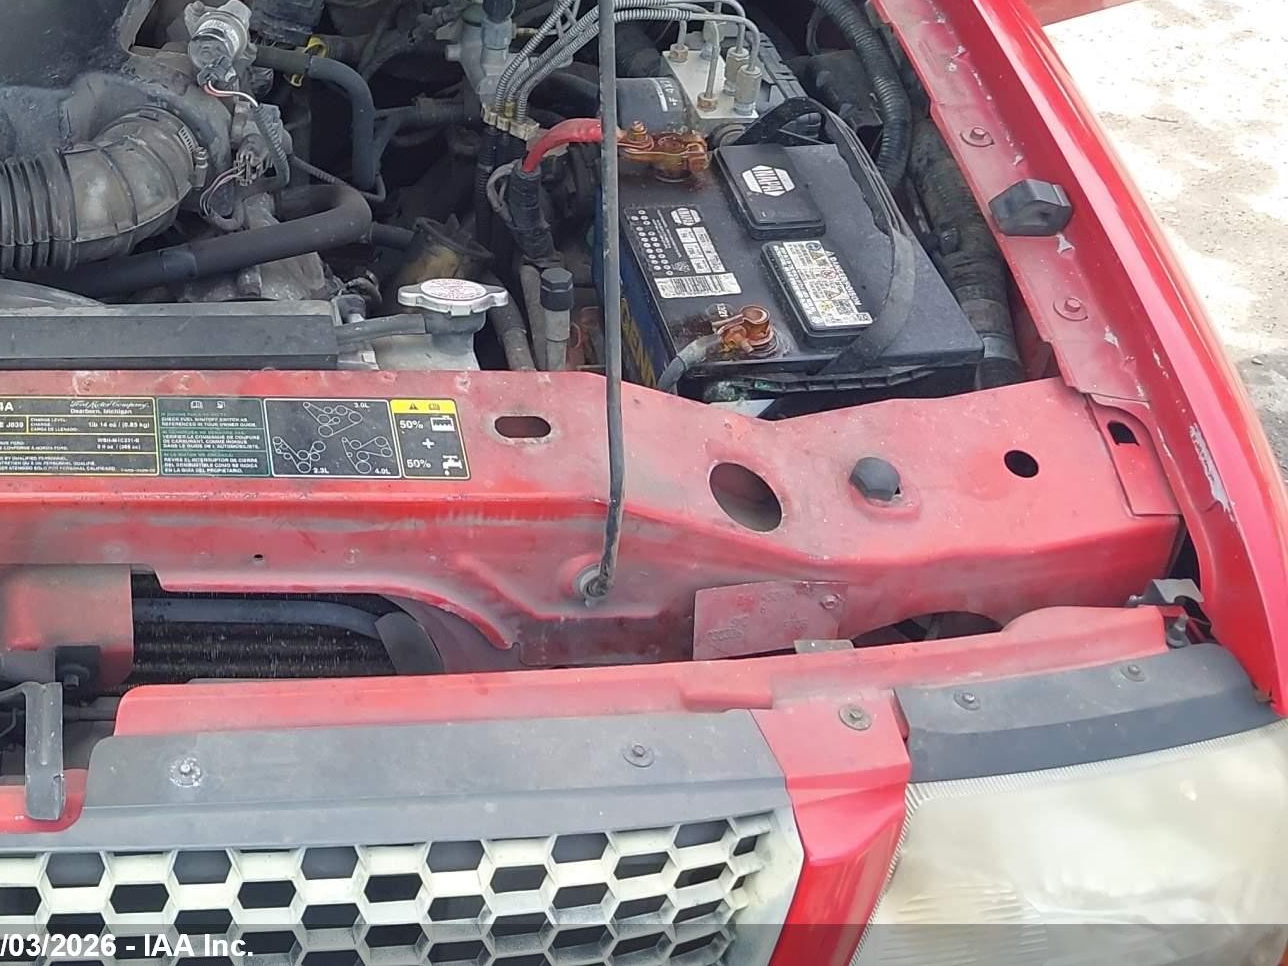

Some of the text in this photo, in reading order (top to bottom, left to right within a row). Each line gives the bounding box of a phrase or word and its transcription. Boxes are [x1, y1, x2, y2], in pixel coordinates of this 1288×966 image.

[752, 170, 786, 193] NAPA
[399, 420, 424, 430] 50%
[407, 459, 432, 469] 50%
